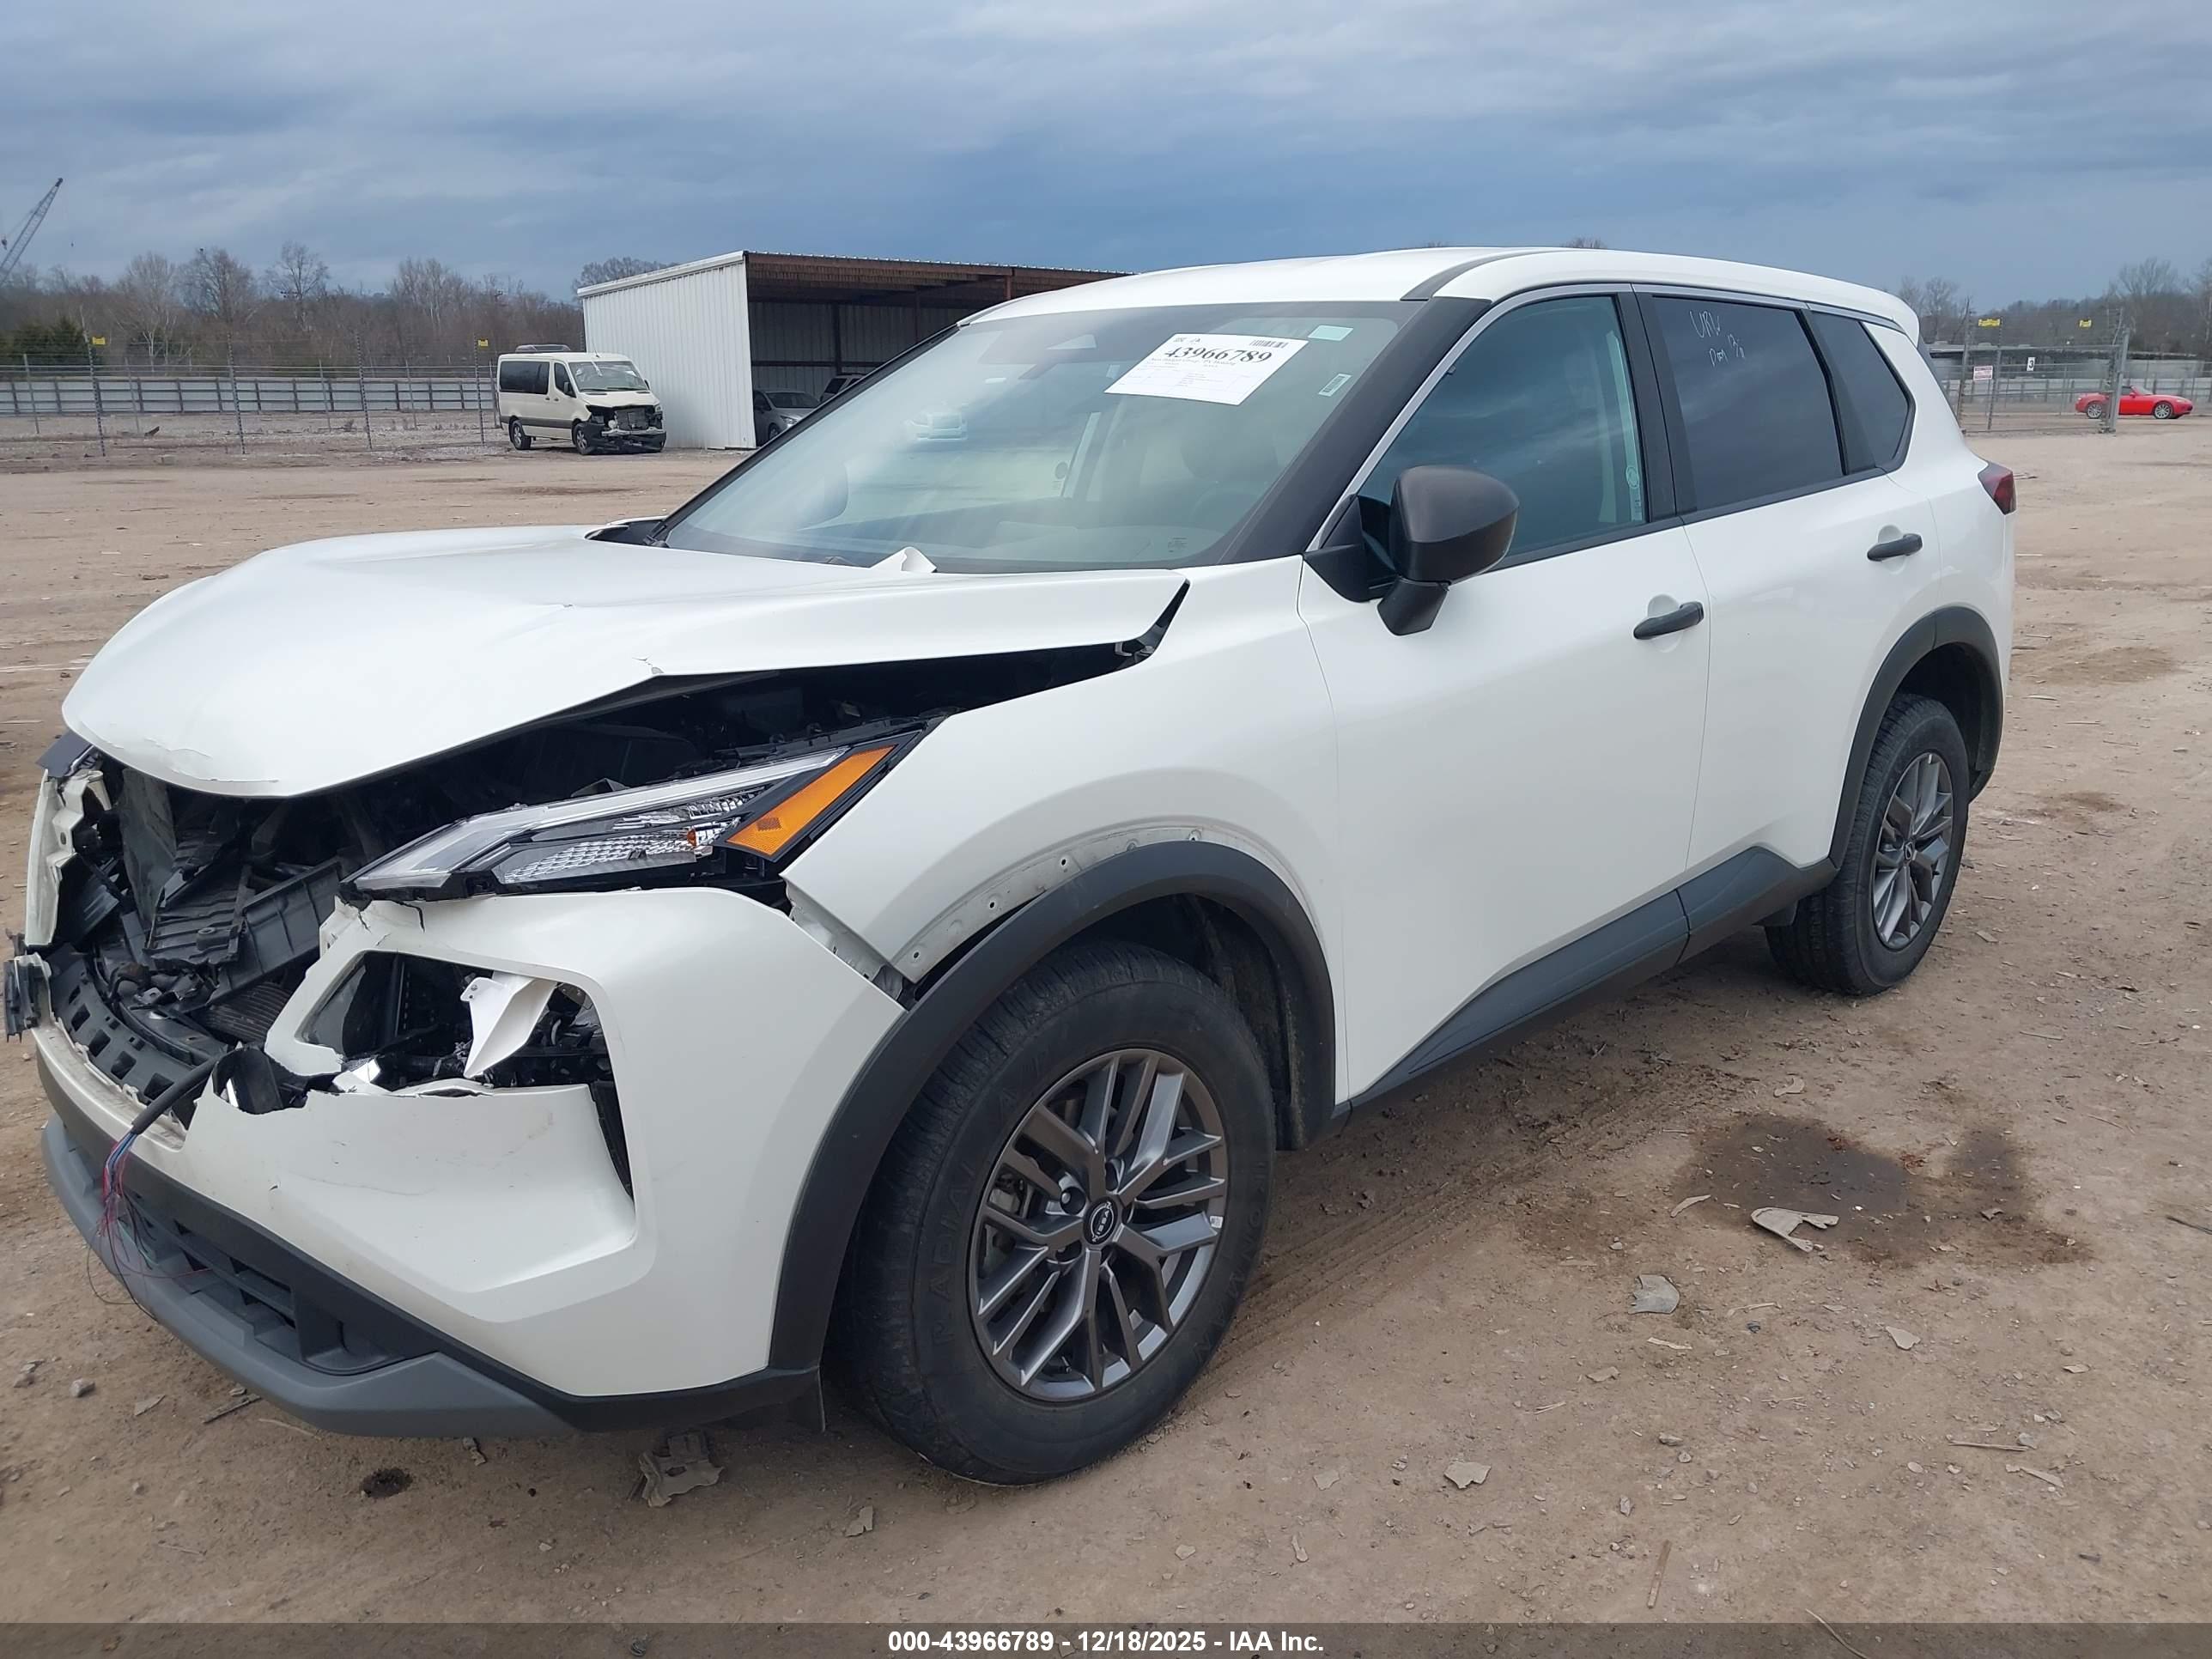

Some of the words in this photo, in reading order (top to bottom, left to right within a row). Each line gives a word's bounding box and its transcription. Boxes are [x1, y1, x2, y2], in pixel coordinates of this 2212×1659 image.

[1165, 347, 1272, 362] 43966789
[2028, 360, 2034, 369] 3
[1092, 1201, 1112, 1243] NISSAN
